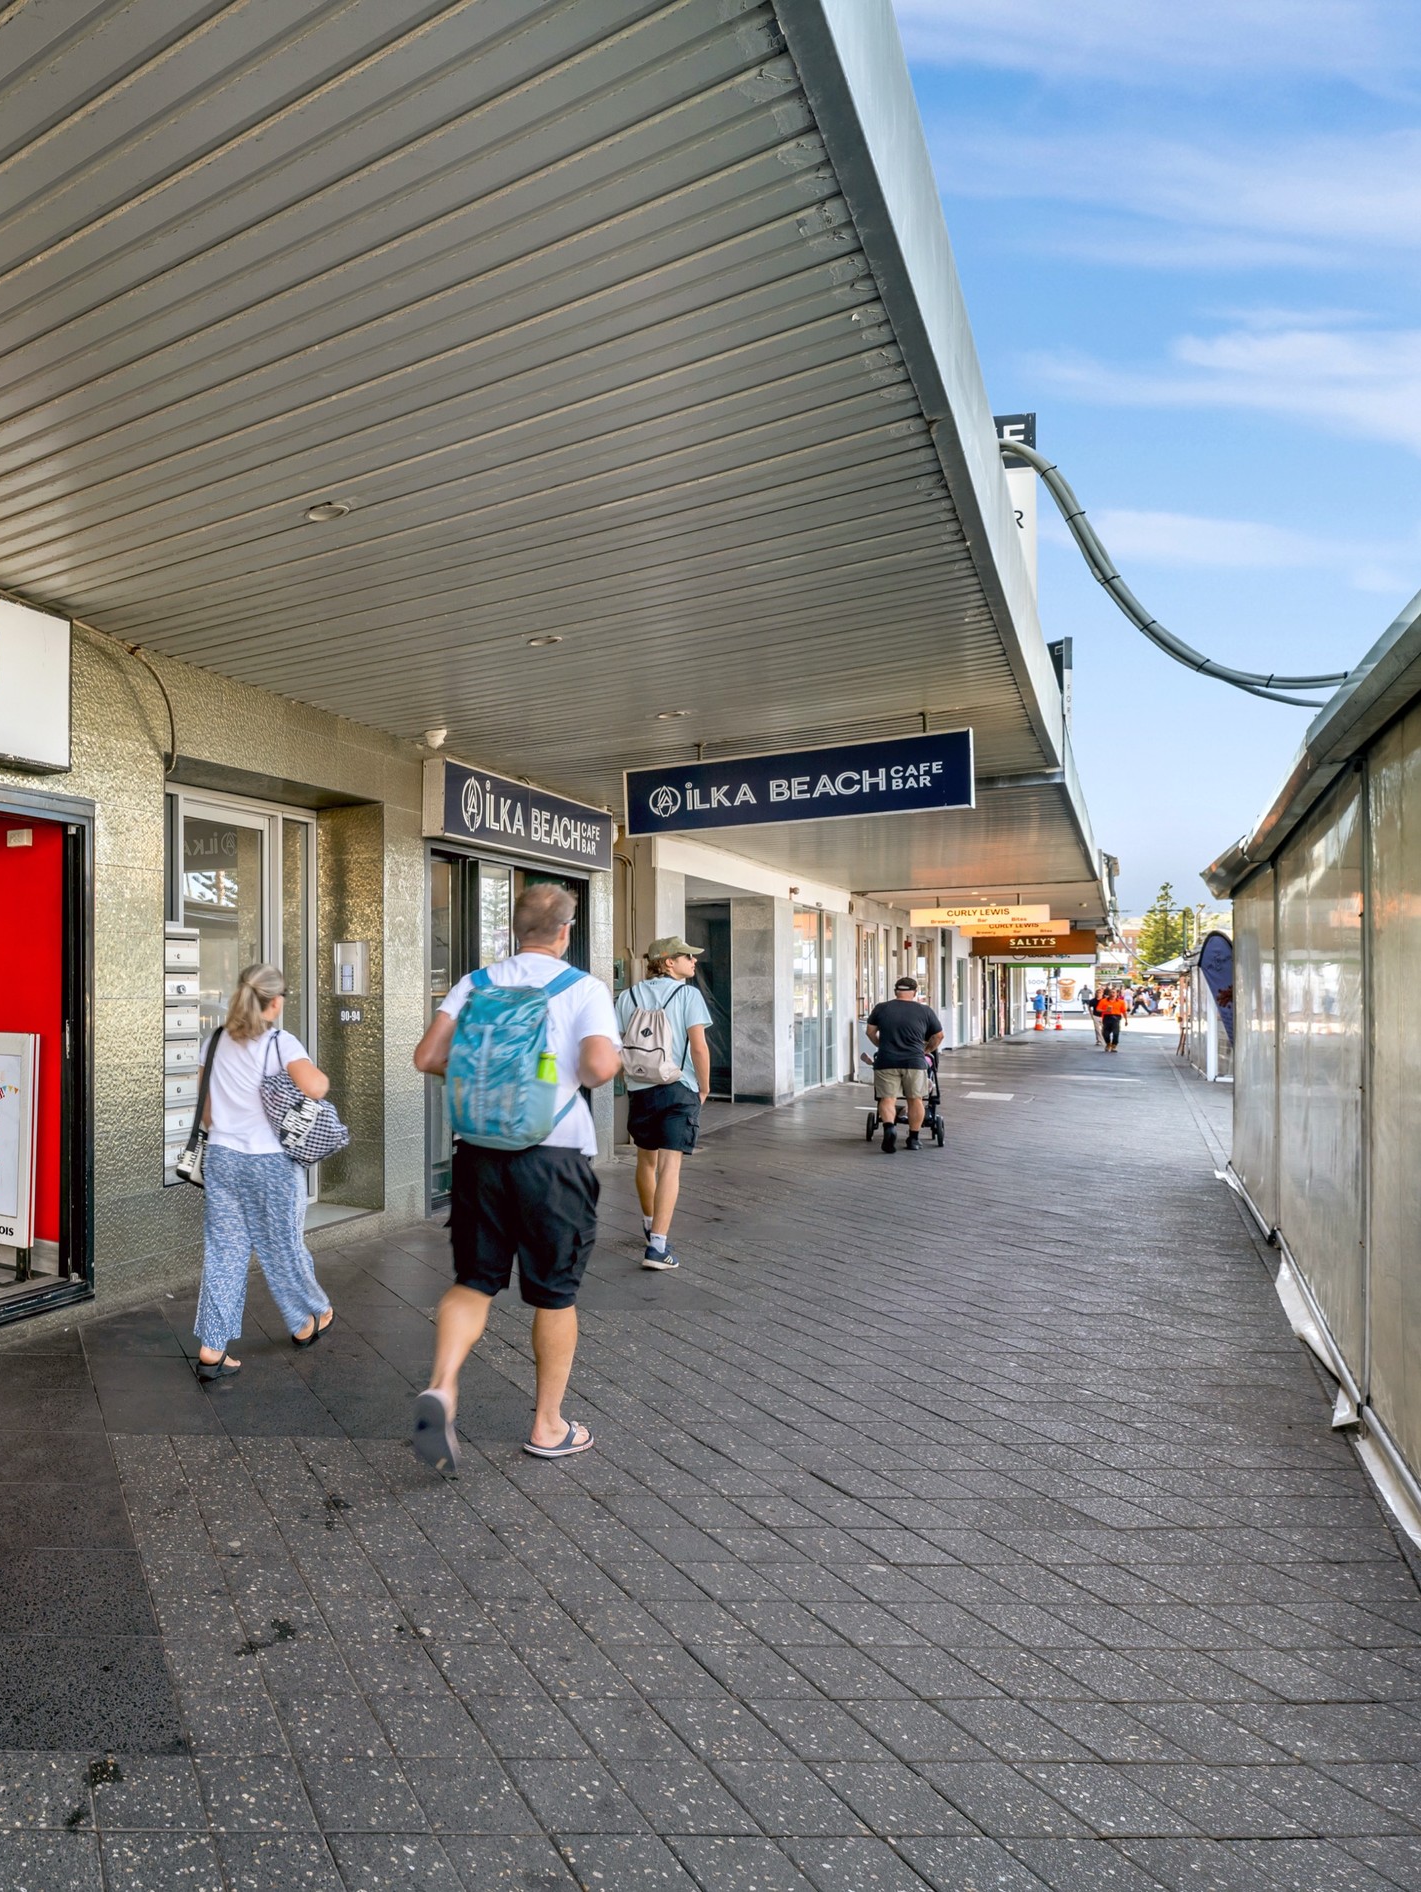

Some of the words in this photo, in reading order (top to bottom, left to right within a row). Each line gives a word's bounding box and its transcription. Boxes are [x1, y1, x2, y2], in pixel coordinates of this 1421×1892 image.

[890, 761, 943, 777] CAFE
[770, 768, 886, 802] BEACH
[892, 775, 932, 790] BAR
[531, 807, 580, 851] BEACH
[582, 823, 600, 841] CAFE
[582, 842, 596, 856] BAR
[980, 908, 1010, 916] LEWIS
[1009, 938, 1056, 946] SALTY'S
[341, 1011, 360, 1021] 90-94
